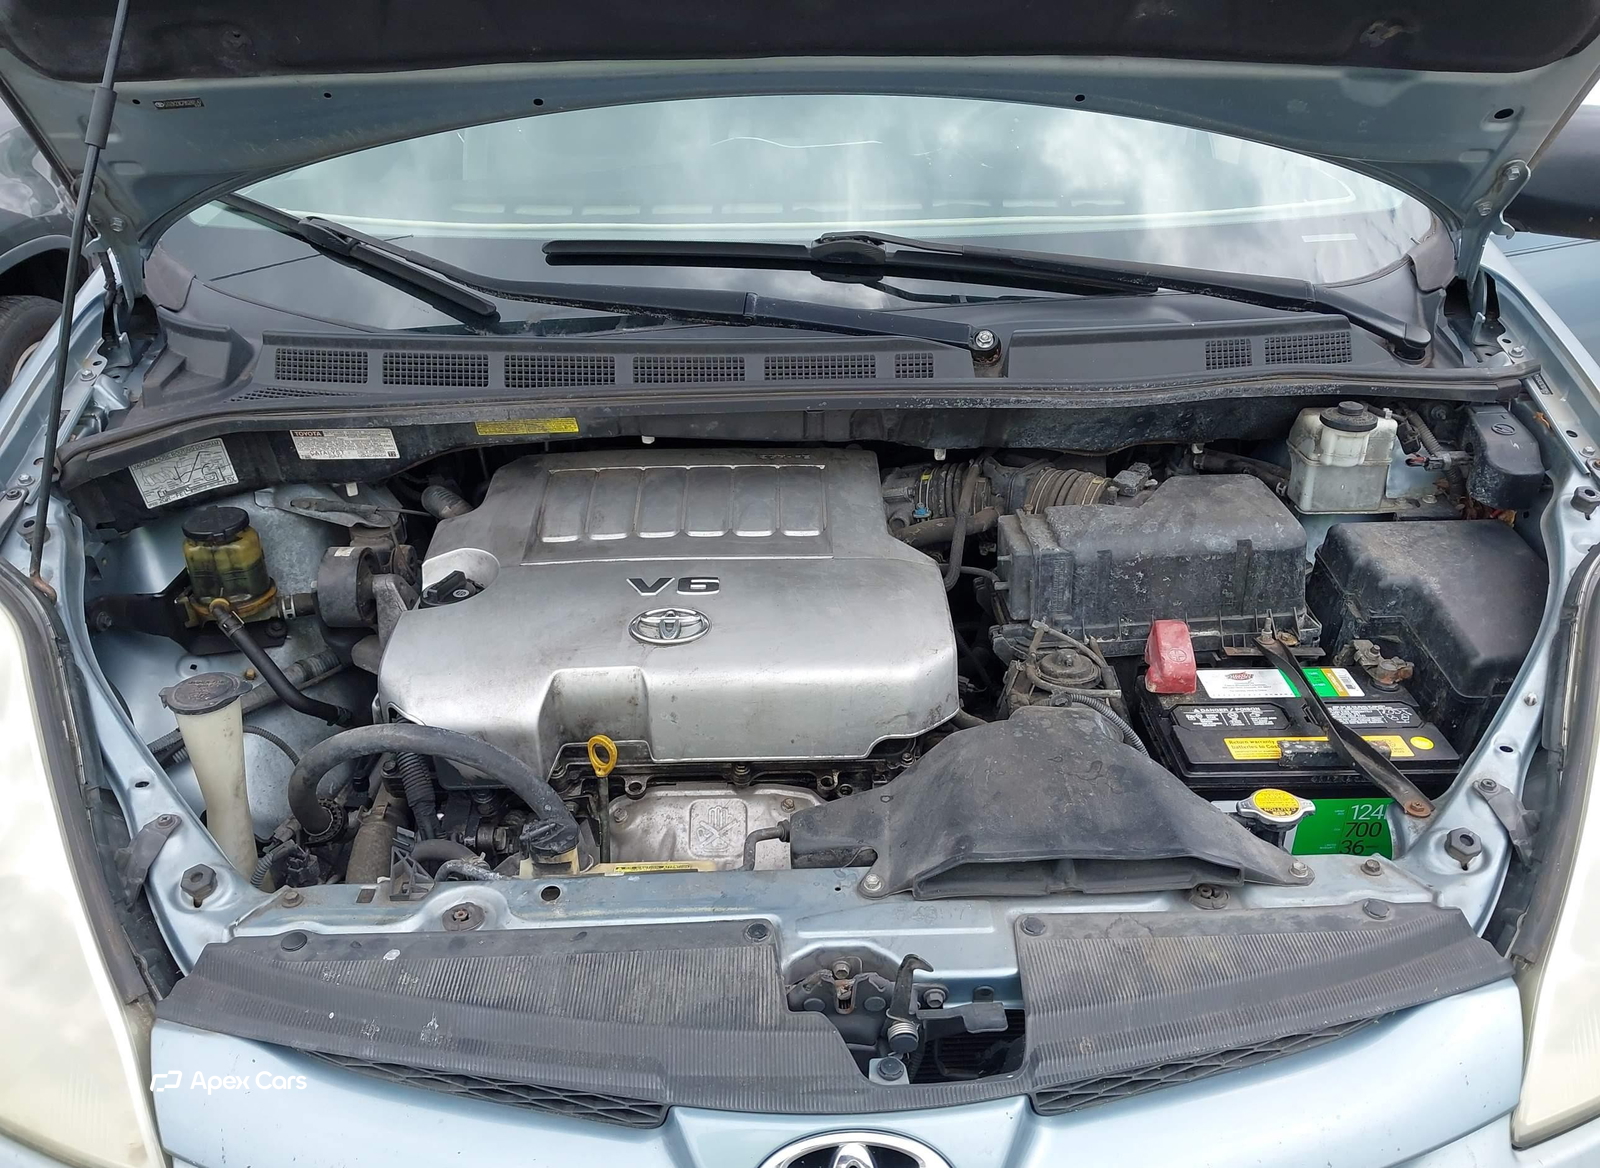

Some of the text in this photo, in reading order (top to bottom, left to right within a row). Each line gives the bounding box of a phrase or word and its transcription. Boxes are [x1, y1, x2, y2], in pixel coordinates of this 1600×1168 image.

[626, 576, 720, 596] V6
[1351, 804, 1388, 820] 124
[1345, 821, 1383, 838] 700
[1340, 839, 1365, 855] 36
